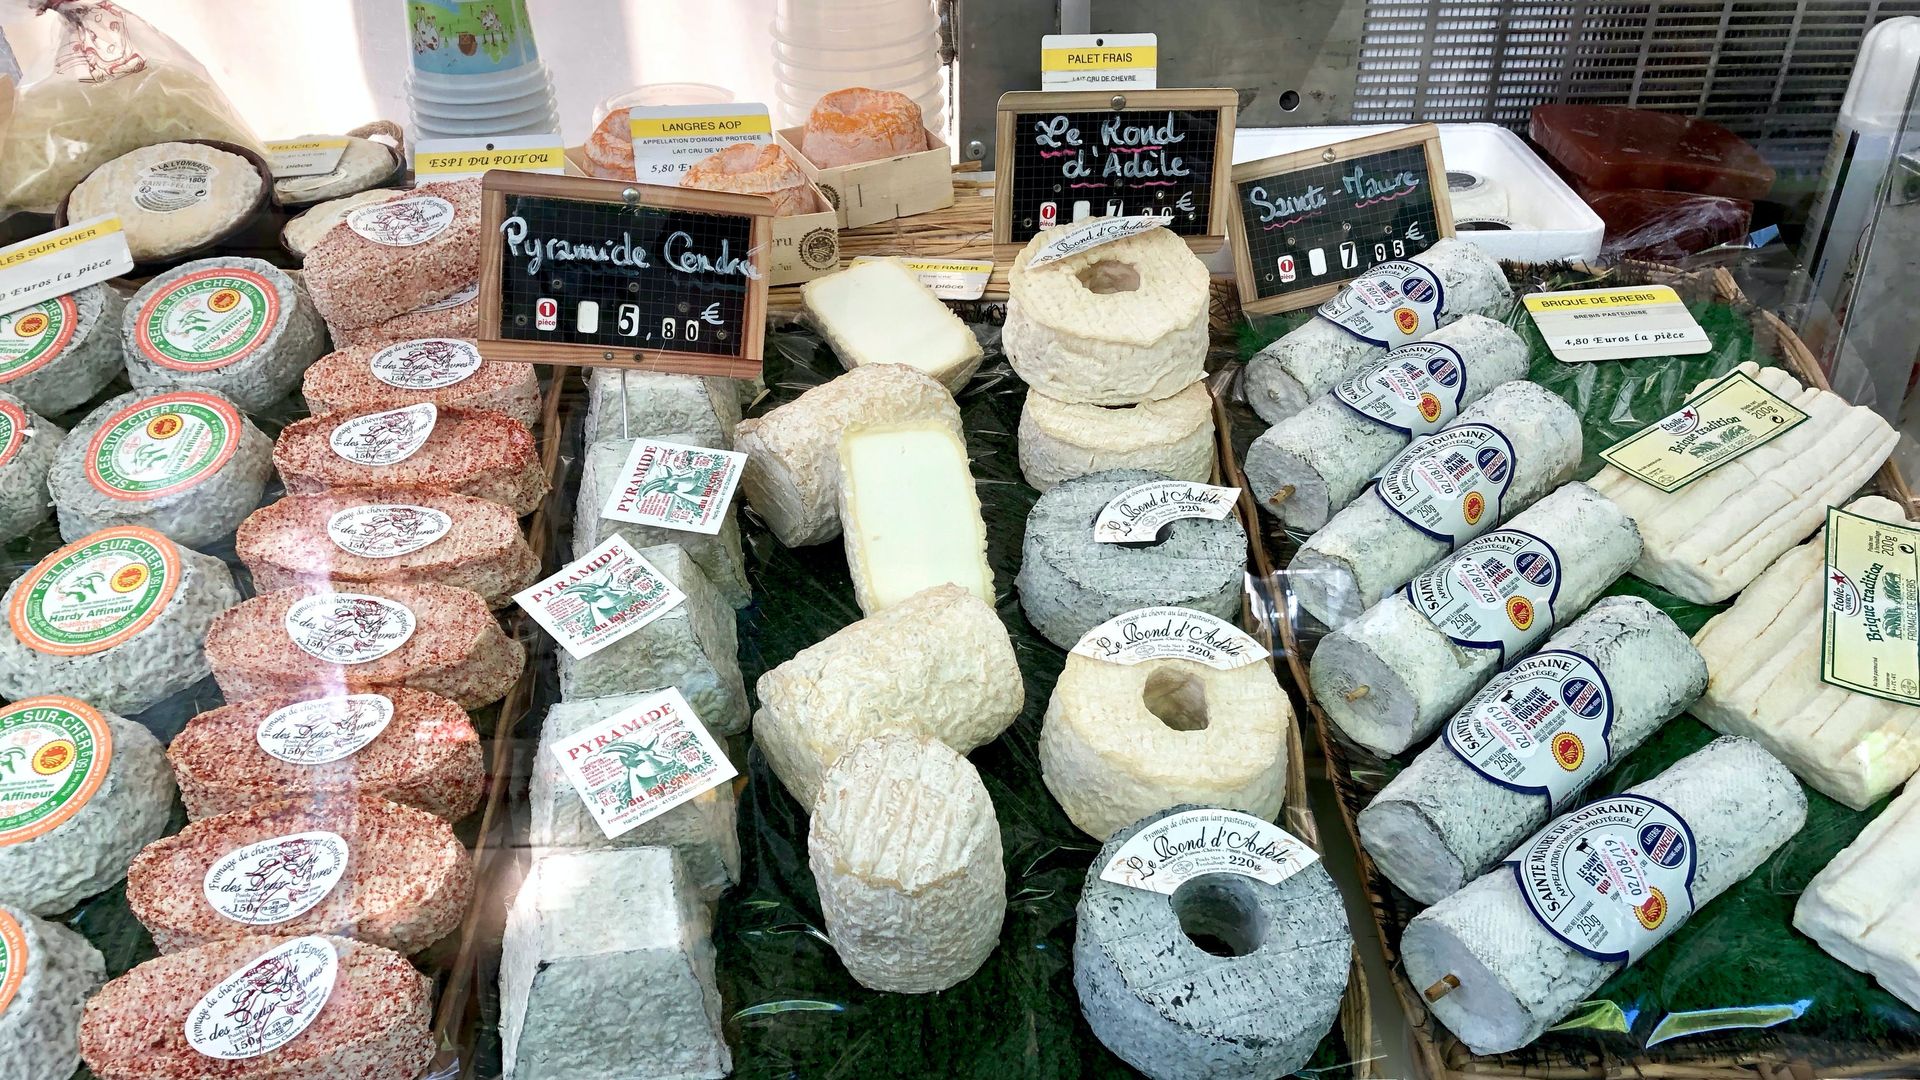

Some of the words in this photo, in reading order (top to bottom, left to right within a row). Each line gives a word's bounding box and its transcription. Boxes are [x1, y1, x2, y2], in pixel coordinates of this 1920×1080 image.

[1068, 54, 1100, 64] PALET
[1102, 53, 1133, 63] FRAIS
[662, 122, 716, 132] LANGRES
[718, 121, 742, 130] AOP
[1035, 115, 1083, 148] Le
[1101, 111, 1185, 146] Rond
[643, 137, 689, 145] APPELLATION
[429, 157, 462, 168] ESPI
[467, 156, 490, 166] DU
[494, 154, 549, 165] POITOU
[651, 164, 675, 173] 5,80
[1062, 146, 1190, 178] d'Adèle
[1176, 191, 1195, 211] €
[1405, 221, 1425, 241] €
[28, 243, 56, 256] SUR
[59, 229, 97, 246] CHER
[500, 216, 650, 276] Pyramide
[11, 279, 51, 296] Euros
[57, 273, 72, 281] la
[77, 258, 112, 277] pièce
[1408, 280, 1431, 300] VERNEUIL
[1541, 298, 1588, 308] BRIQUE
[1610, 293, 1655, 303] BREBIS
[150, 279, 241, 343] SELLES-SUR-CHER
[701, 302, 725, 325] €
[1602, 310, 1648, 318] PASTEURISE
[193, 333, 221, 352] Hardy
[221, 310, 252, 335] Affineur
[537, 318, 557, 326] pièce
[1564, 338, 1589, 346] 4,80
[1593, 335, 1630, 344] Euros
[1654, 331, 1685, 343] pièce
[382, 361, 398, 370] des
[1750, 405, 1778, 420] 200g
[1425, 430, 1487, 446] TOURAINE
[1668, 432, 1699, 455] Brique
[1696, 415, 1741, 436] tradition
[98, 405, 171, 490] SELLES-SUR-CHER
[1484, 453, 1505, 477] VERNEUIL
[617, 445, 658, 513] PYRAMIDE
[1420, 461, 1453, 494] 02/08/19
[1160, 487, 1220, 506] d'Adèle
[1119, 493, 1158, 521] Rond
[1178, 504, 1206, 513] 220g
[1417, 504, 1437, 519] 250g
[1107, 520, 1132, 536] Le
[1472, 543, 1512, 551] PROTÉGÉE
[1882, 535, 1898, 556] 200g
[36, 538, 162, 592] SELLES-SUR-CHER
[531, 545, 624, 604] PYRAMIDE
[1523, 555, 1548, 580] VERNEUIL
[1461, 563, 1496, 603] 02/08/19
[1860, 563, 1884, 601] tradition
[1833, 587, 1845, 611] Étoile
[49, 611, 85, 623] Hardy
[86, 604, 134, 618] Affineur
[299, 617, 317, 629] des
[1188, 613, 1219, 626] pasteurisé
[1451, 612, 1473, 630] 250g
[1862, 604, 1884, 642] Brique
[594, 621, 608, 633] au
[1907, 610, 1918, 641] FROMAGE
[1097, 636, 1123, 657] Le
[1123, 619, 1170, 645] Rond
[1174, 620, 1241, 657] d'Adèle
[1186, 644, 1216, 661] 220g
[1514, 670, 1558, 681] PROTÉGÉE
[1565, 681, 1584, 697] LAITERIE
[1571, 683, 1597, 714] VERNEUIL
[1458, 717, 1480, 750] SAINTE
[1503, 658, 1572, 681] TOURAINE
[1538, 699, 1560, 723] préfère
[261, 712, 288, 739] Fromage
[272, 728, 290, 740] des
[567, 702, 676, 761] PYRAMIDE
[1487, 706, 1531, 749] 02/08/19
[281, 747, 305, 757] 150g
[684, 750, 701, 763] 180g
[1494, 752, 1518, 771] 250g
[2, 789, 54, 802] Affineur
[628, 794, 645, 808] au
[671, 772, 690, 786] cru
[1569, 804, 1645, 825] TOURAINE
[1585, 816, 1633, 829] PROTÉGÉE
[1142, 825, 1170, 843] Fromage
[1170, 821, 1178, 829] de
[1178, 816, 1199, 827] chèvre
[1223, 815, 1258, 829] pasteurisé
[1554, 821, 1572, 839] DE
[1557, 825, 1586, 850] D'ORIGINE
[1643, 827, 1661, 845] LAITERIE
[1127, 856, 1157, 881] Le
[1153, 826, 1206, 862] Rond
[1211, 826, 1287, 865] d'Adèle
[1531, 833, 1557, 865] MAURE
[1652, 828, 1677, 863] VERNEUIL
[209, 858, 237, 891] Fromage
[238, 850, 249, 861] de
[251, 844, 279, 856] chèvre
[1229, 855, 1262, 872] 220g
[1554, 849, 1568, 897] APPELLATION
[1576, 868, 1586, 879] LE
[1609, 839, 1642, 896] 02/08/19
[221, 877, 241, 893] des
[1531, 865, 1560, 913] SAINTE
[1584, 873, 1596, 887] DE
[1596, 880, 1611, 895] que
[233, 903, 258, 914] 150g
[1577, 914, 1601, 937] 250g
[193, 1008, 210, 1044] Fromage
[207, 997, 218, 1009] de
[217, 978, 245, 999] chèvre
[294, 942, 329, 966] d'Espelette
[209, 1024, 231, 1041] des
[232, 1036, 262, 1053] 150g
